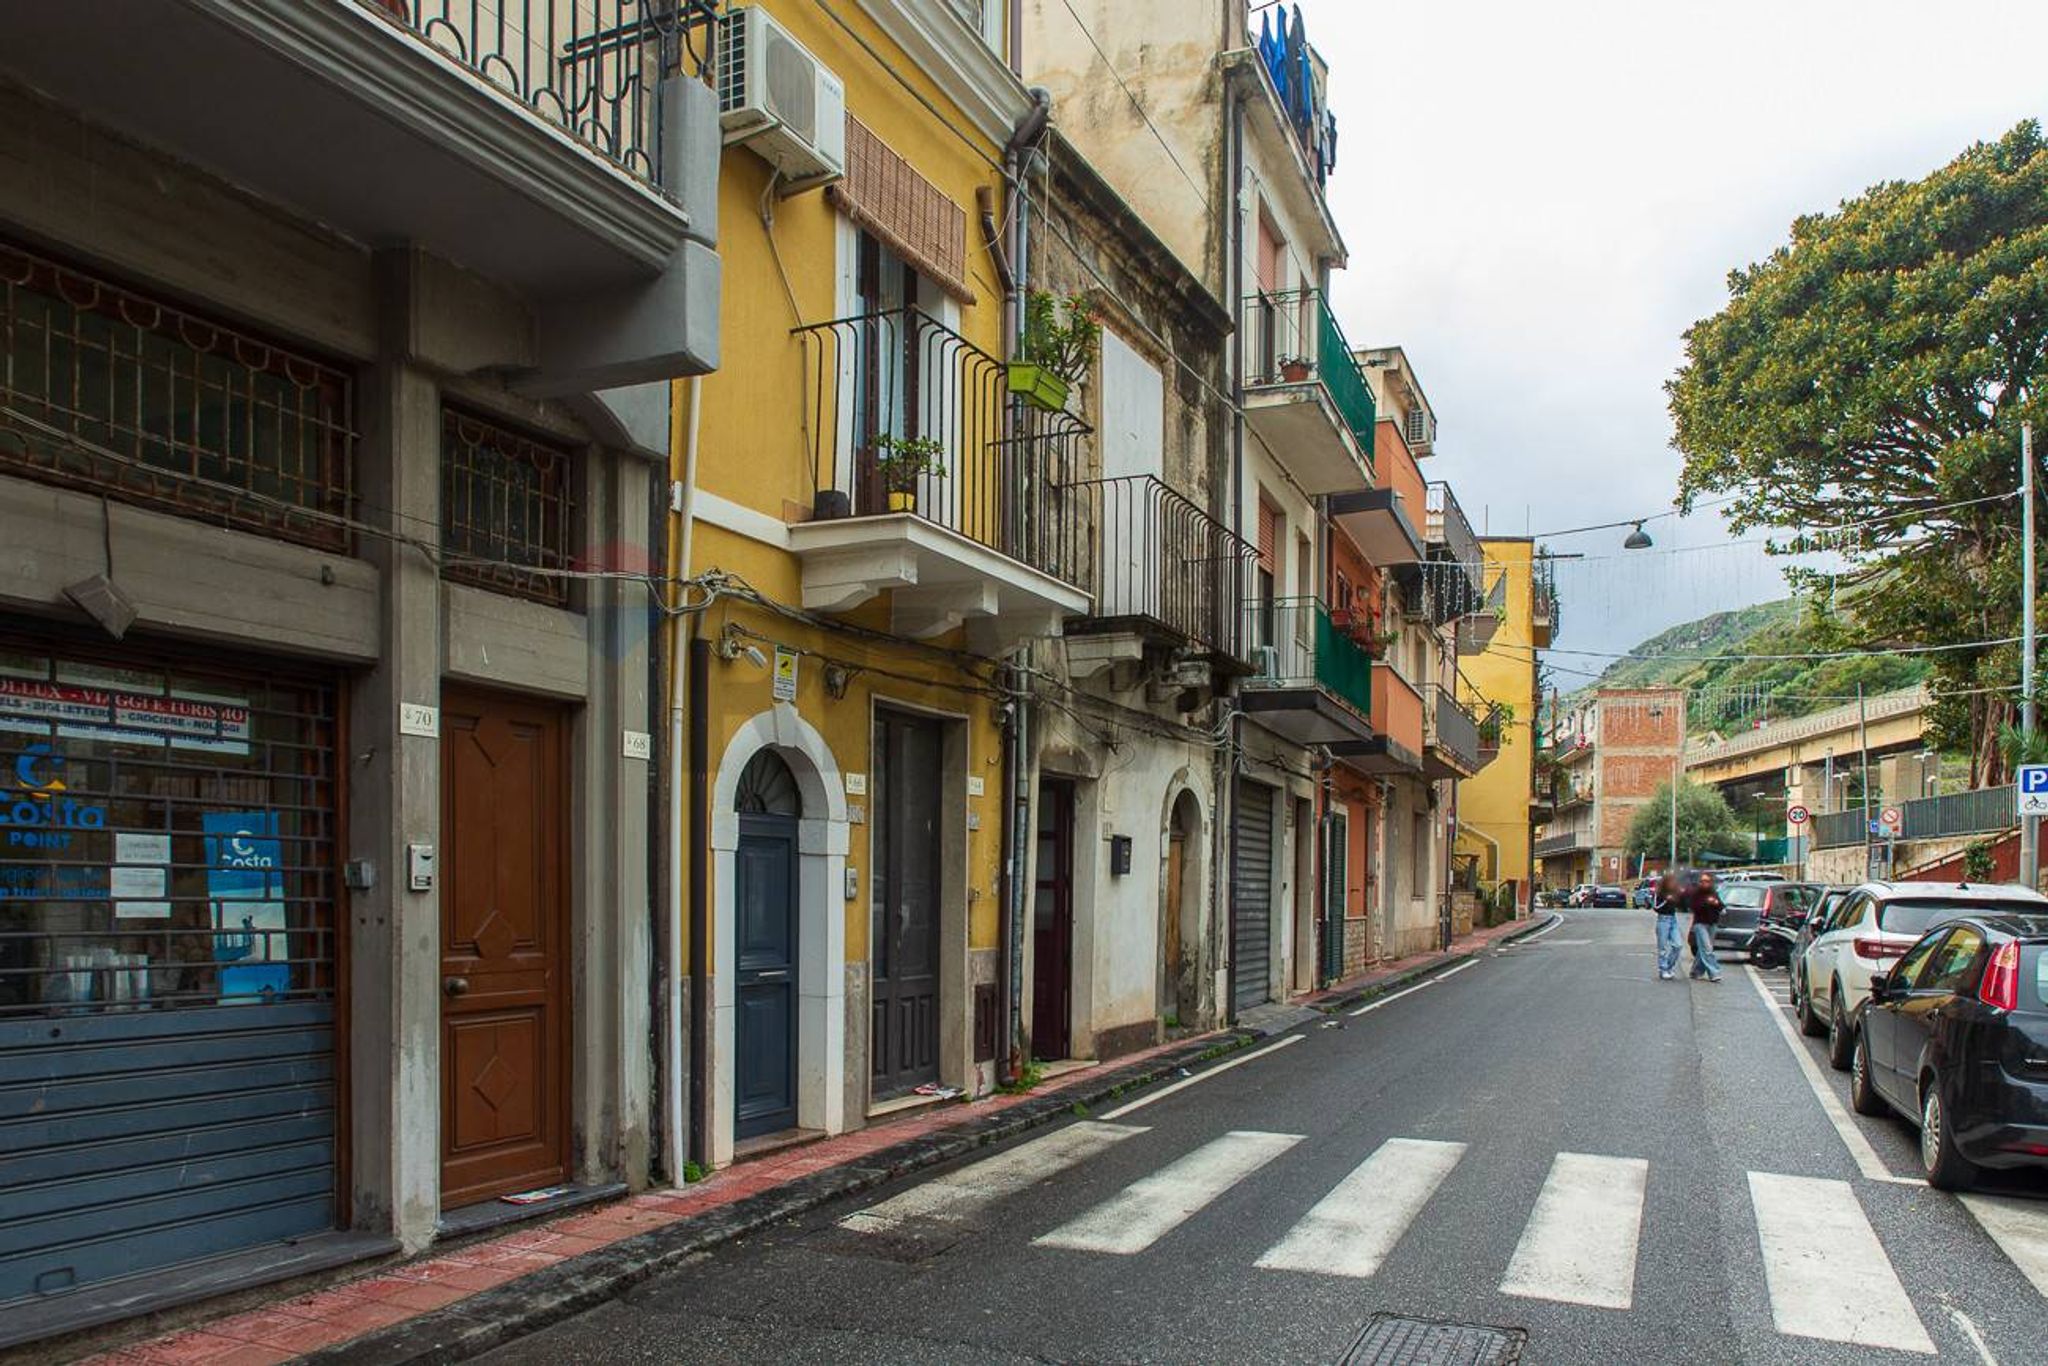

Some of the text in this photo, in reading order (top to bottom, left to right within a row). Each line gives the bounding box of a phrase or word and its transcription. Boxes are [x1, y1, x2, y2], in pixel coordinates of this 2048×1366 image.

[415, 710, 432, 726] 70
[193, 720, 240, 734] NOLGGI
[2029, 770, 2047, 791] P
[8, 831, 73, 848] POINT
